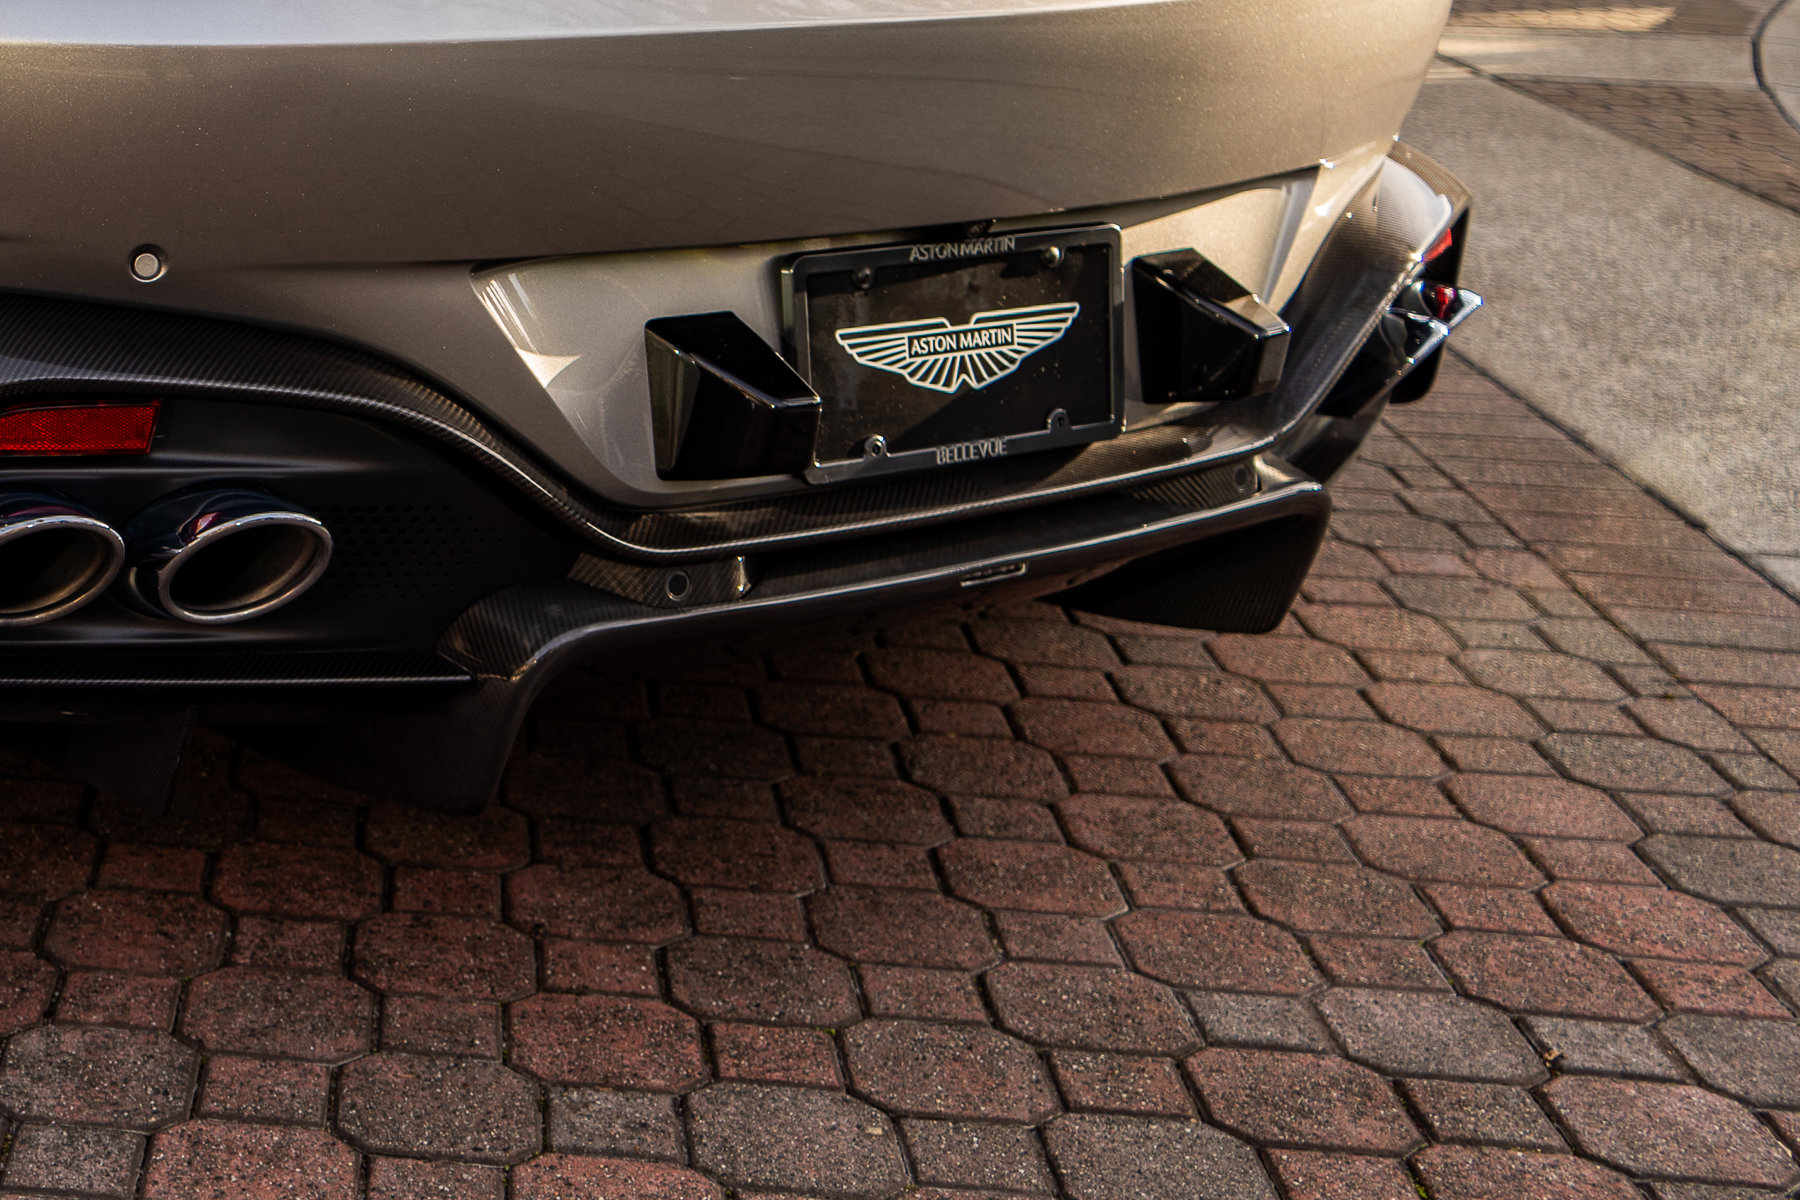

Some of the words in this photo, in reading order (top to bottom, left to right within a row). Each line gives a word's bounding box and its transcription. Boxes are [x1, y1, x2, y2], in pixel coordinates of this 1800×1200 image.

[909, 243, 958, 262] ASTON
[959, 237, 1016, 256] MARTIN
[911, 335, 957, 355] ASTON
[959, 327, 1013, 348] MARTIN
[936, 439, 1009, 466] BELLEVUE
